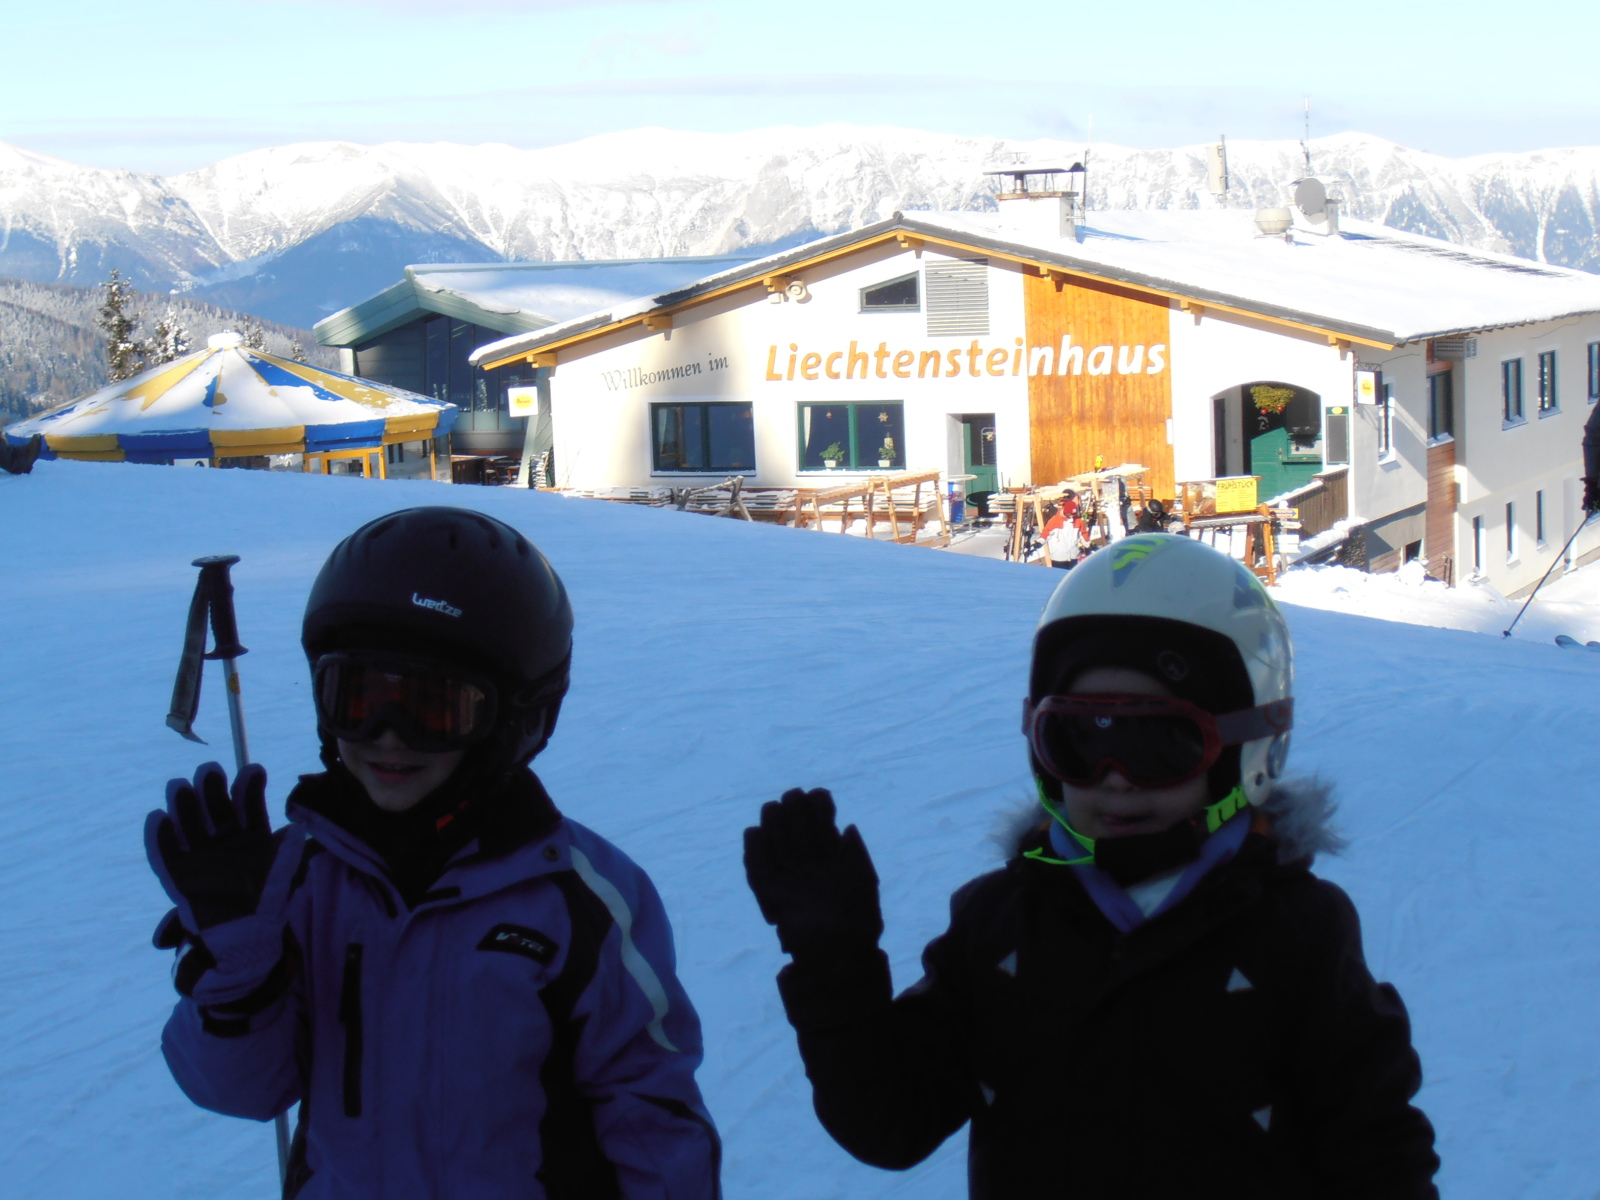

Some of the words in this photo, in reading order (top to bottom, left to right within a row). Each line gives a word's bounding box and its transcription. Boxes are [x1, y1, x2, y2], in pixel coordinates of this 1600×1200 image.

[601, 361, 702, 392] Willkommen
[708, 352, 729, 372] im
[765, 334, 1167, 381] Liechtensteinhaus
